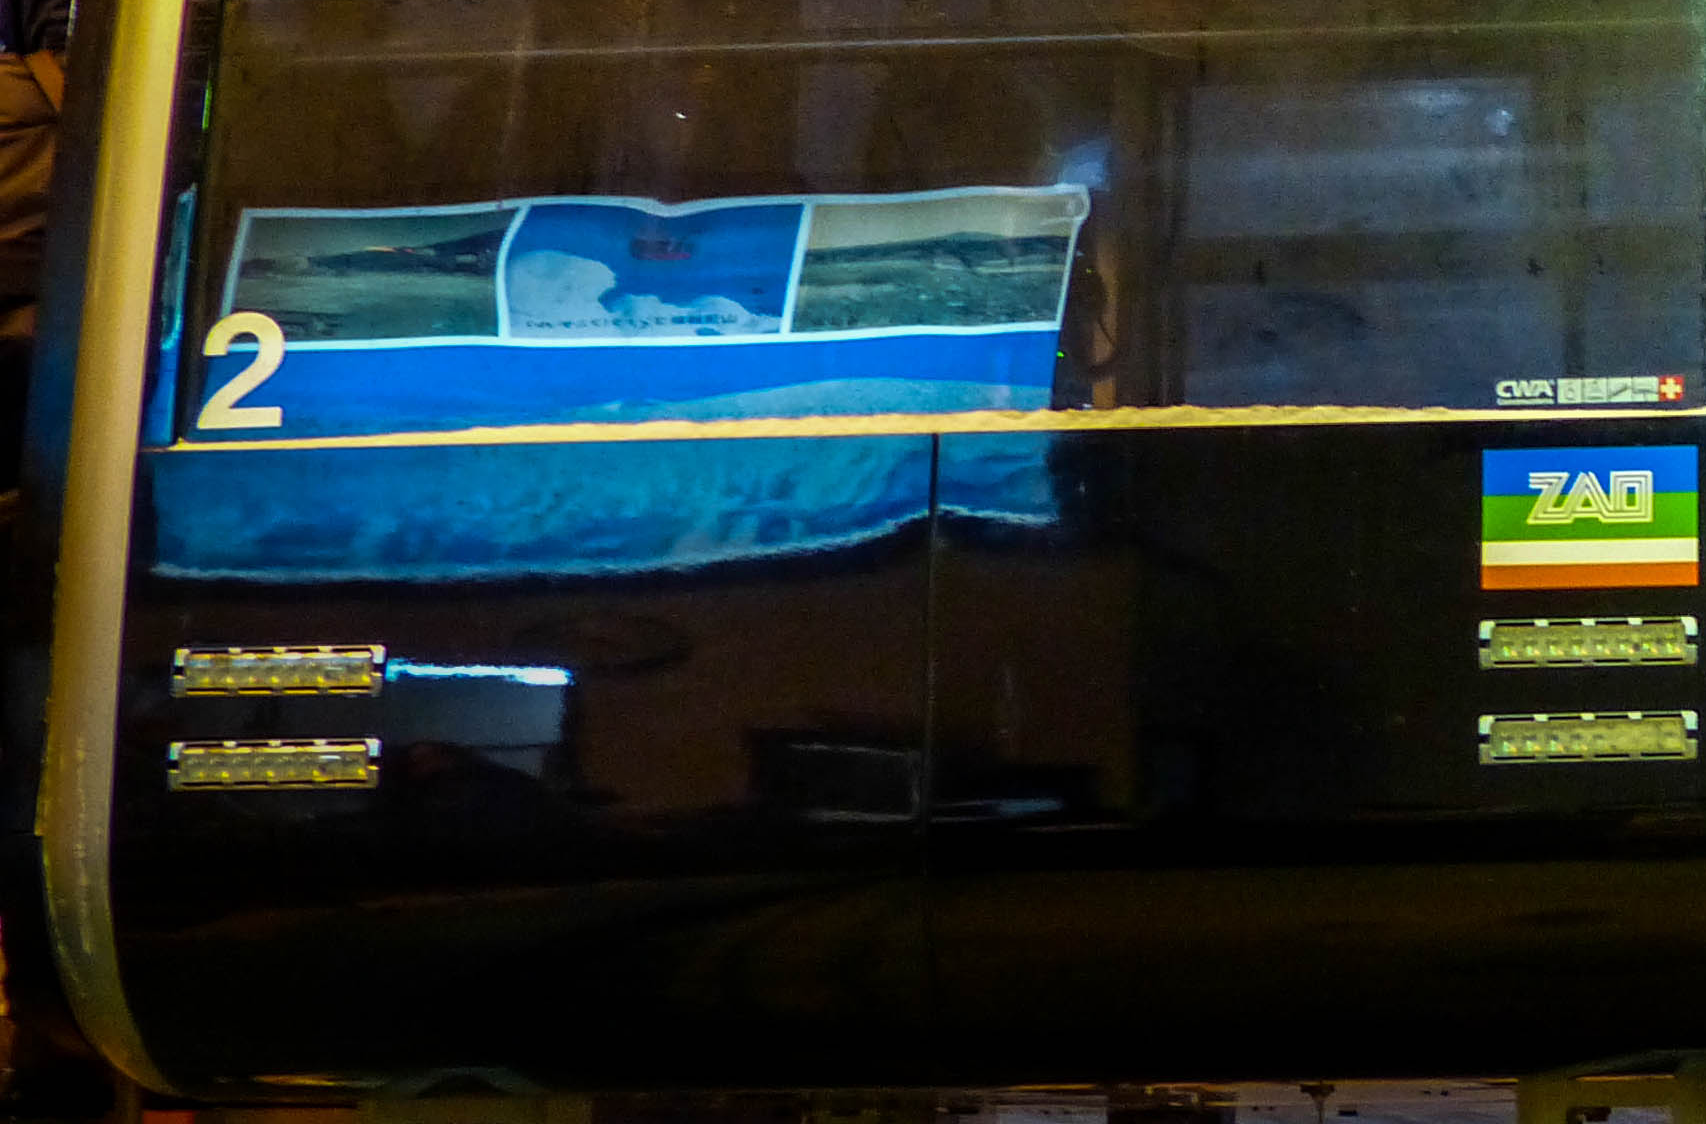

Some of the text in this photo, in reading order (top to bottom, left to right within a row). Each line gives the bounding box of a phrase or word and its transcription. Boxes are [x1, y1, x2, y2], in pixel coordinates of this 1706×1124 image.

[197, 311, 284, 428] 2
[1496, 380, 1554, 397] CWA
[1526, 470, 1653, 524] ZAO
